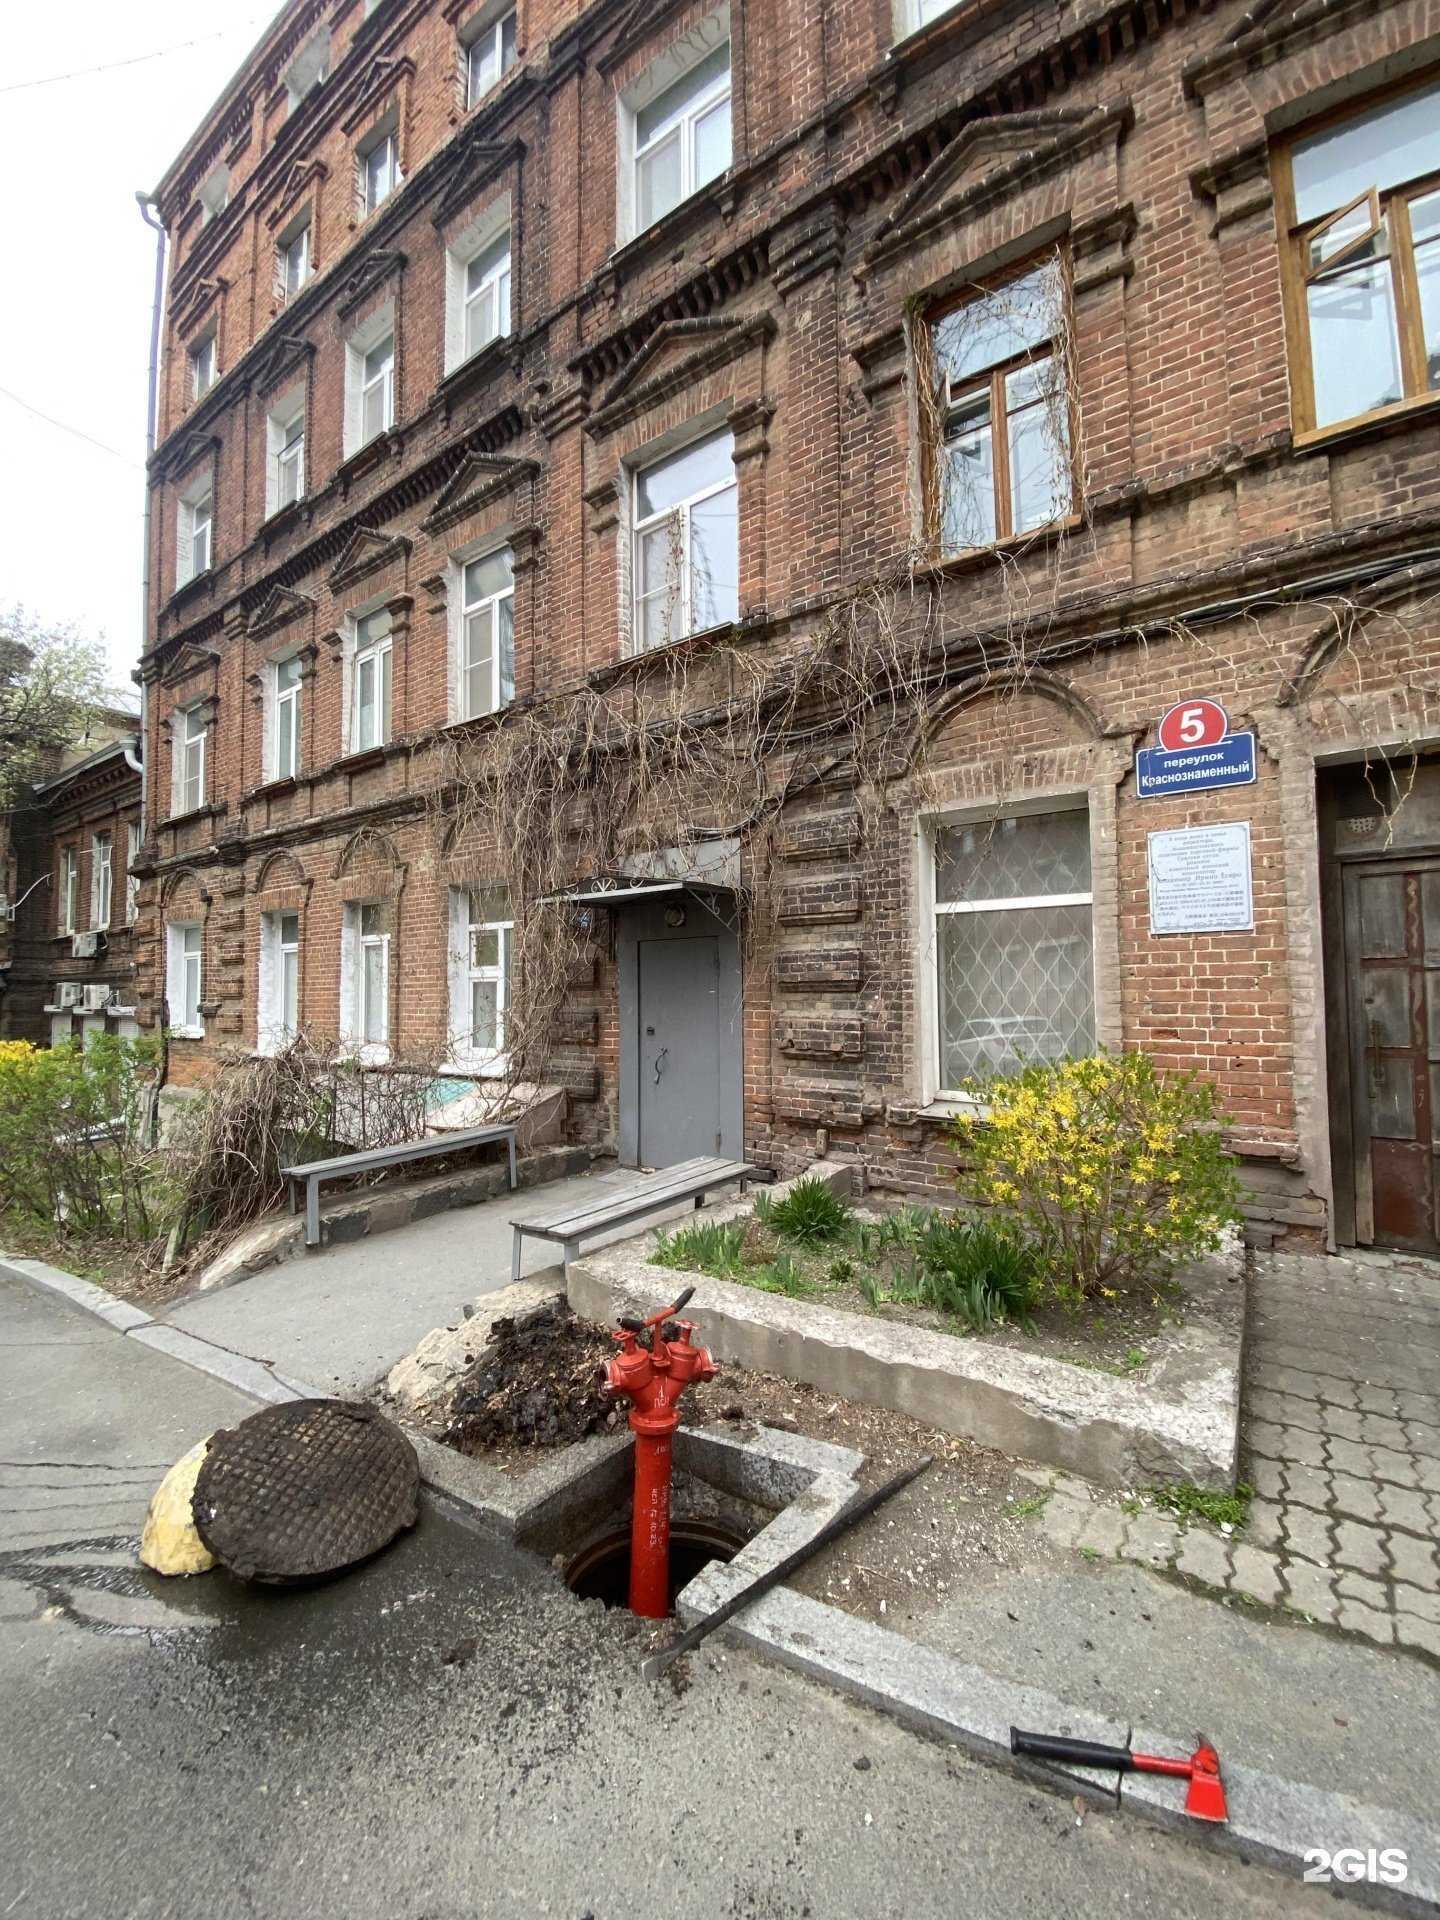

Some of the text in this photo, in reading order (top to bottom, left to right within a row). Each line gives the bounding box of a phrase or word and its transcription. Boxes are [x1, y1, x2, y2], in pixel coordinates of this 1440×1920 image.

[1180, 708, 1205, 743] 5
[1164, 752, 1224, 768] переулок
[1141, 761, 1250, 788] Краснознаменный
